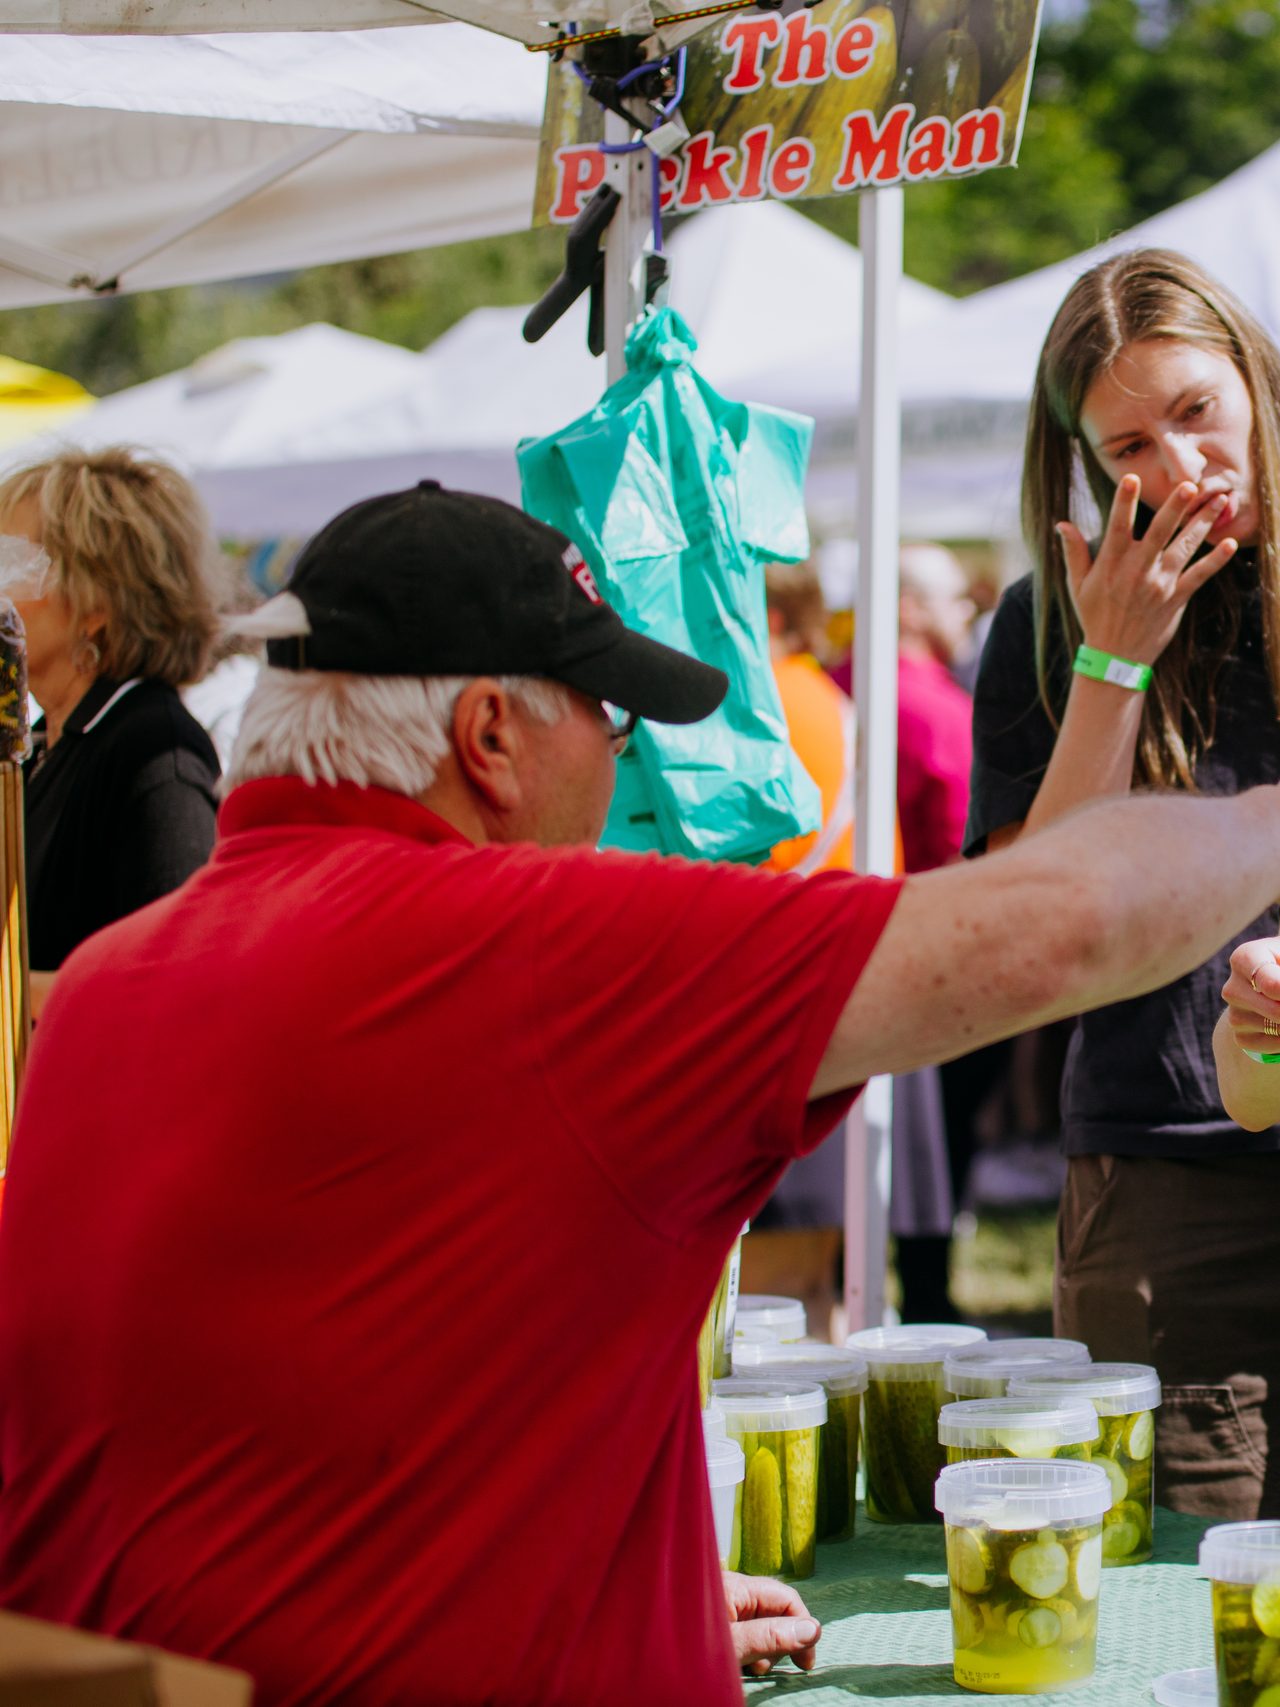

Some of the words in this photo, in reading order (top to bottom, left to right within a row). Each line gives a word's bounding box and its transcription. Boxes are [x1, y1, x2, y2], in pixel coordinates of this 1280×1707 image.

[724, 12, 875, 91] The
[552, 129, 813, 219] Pckle
[836, 107, 1002, 188] Man
